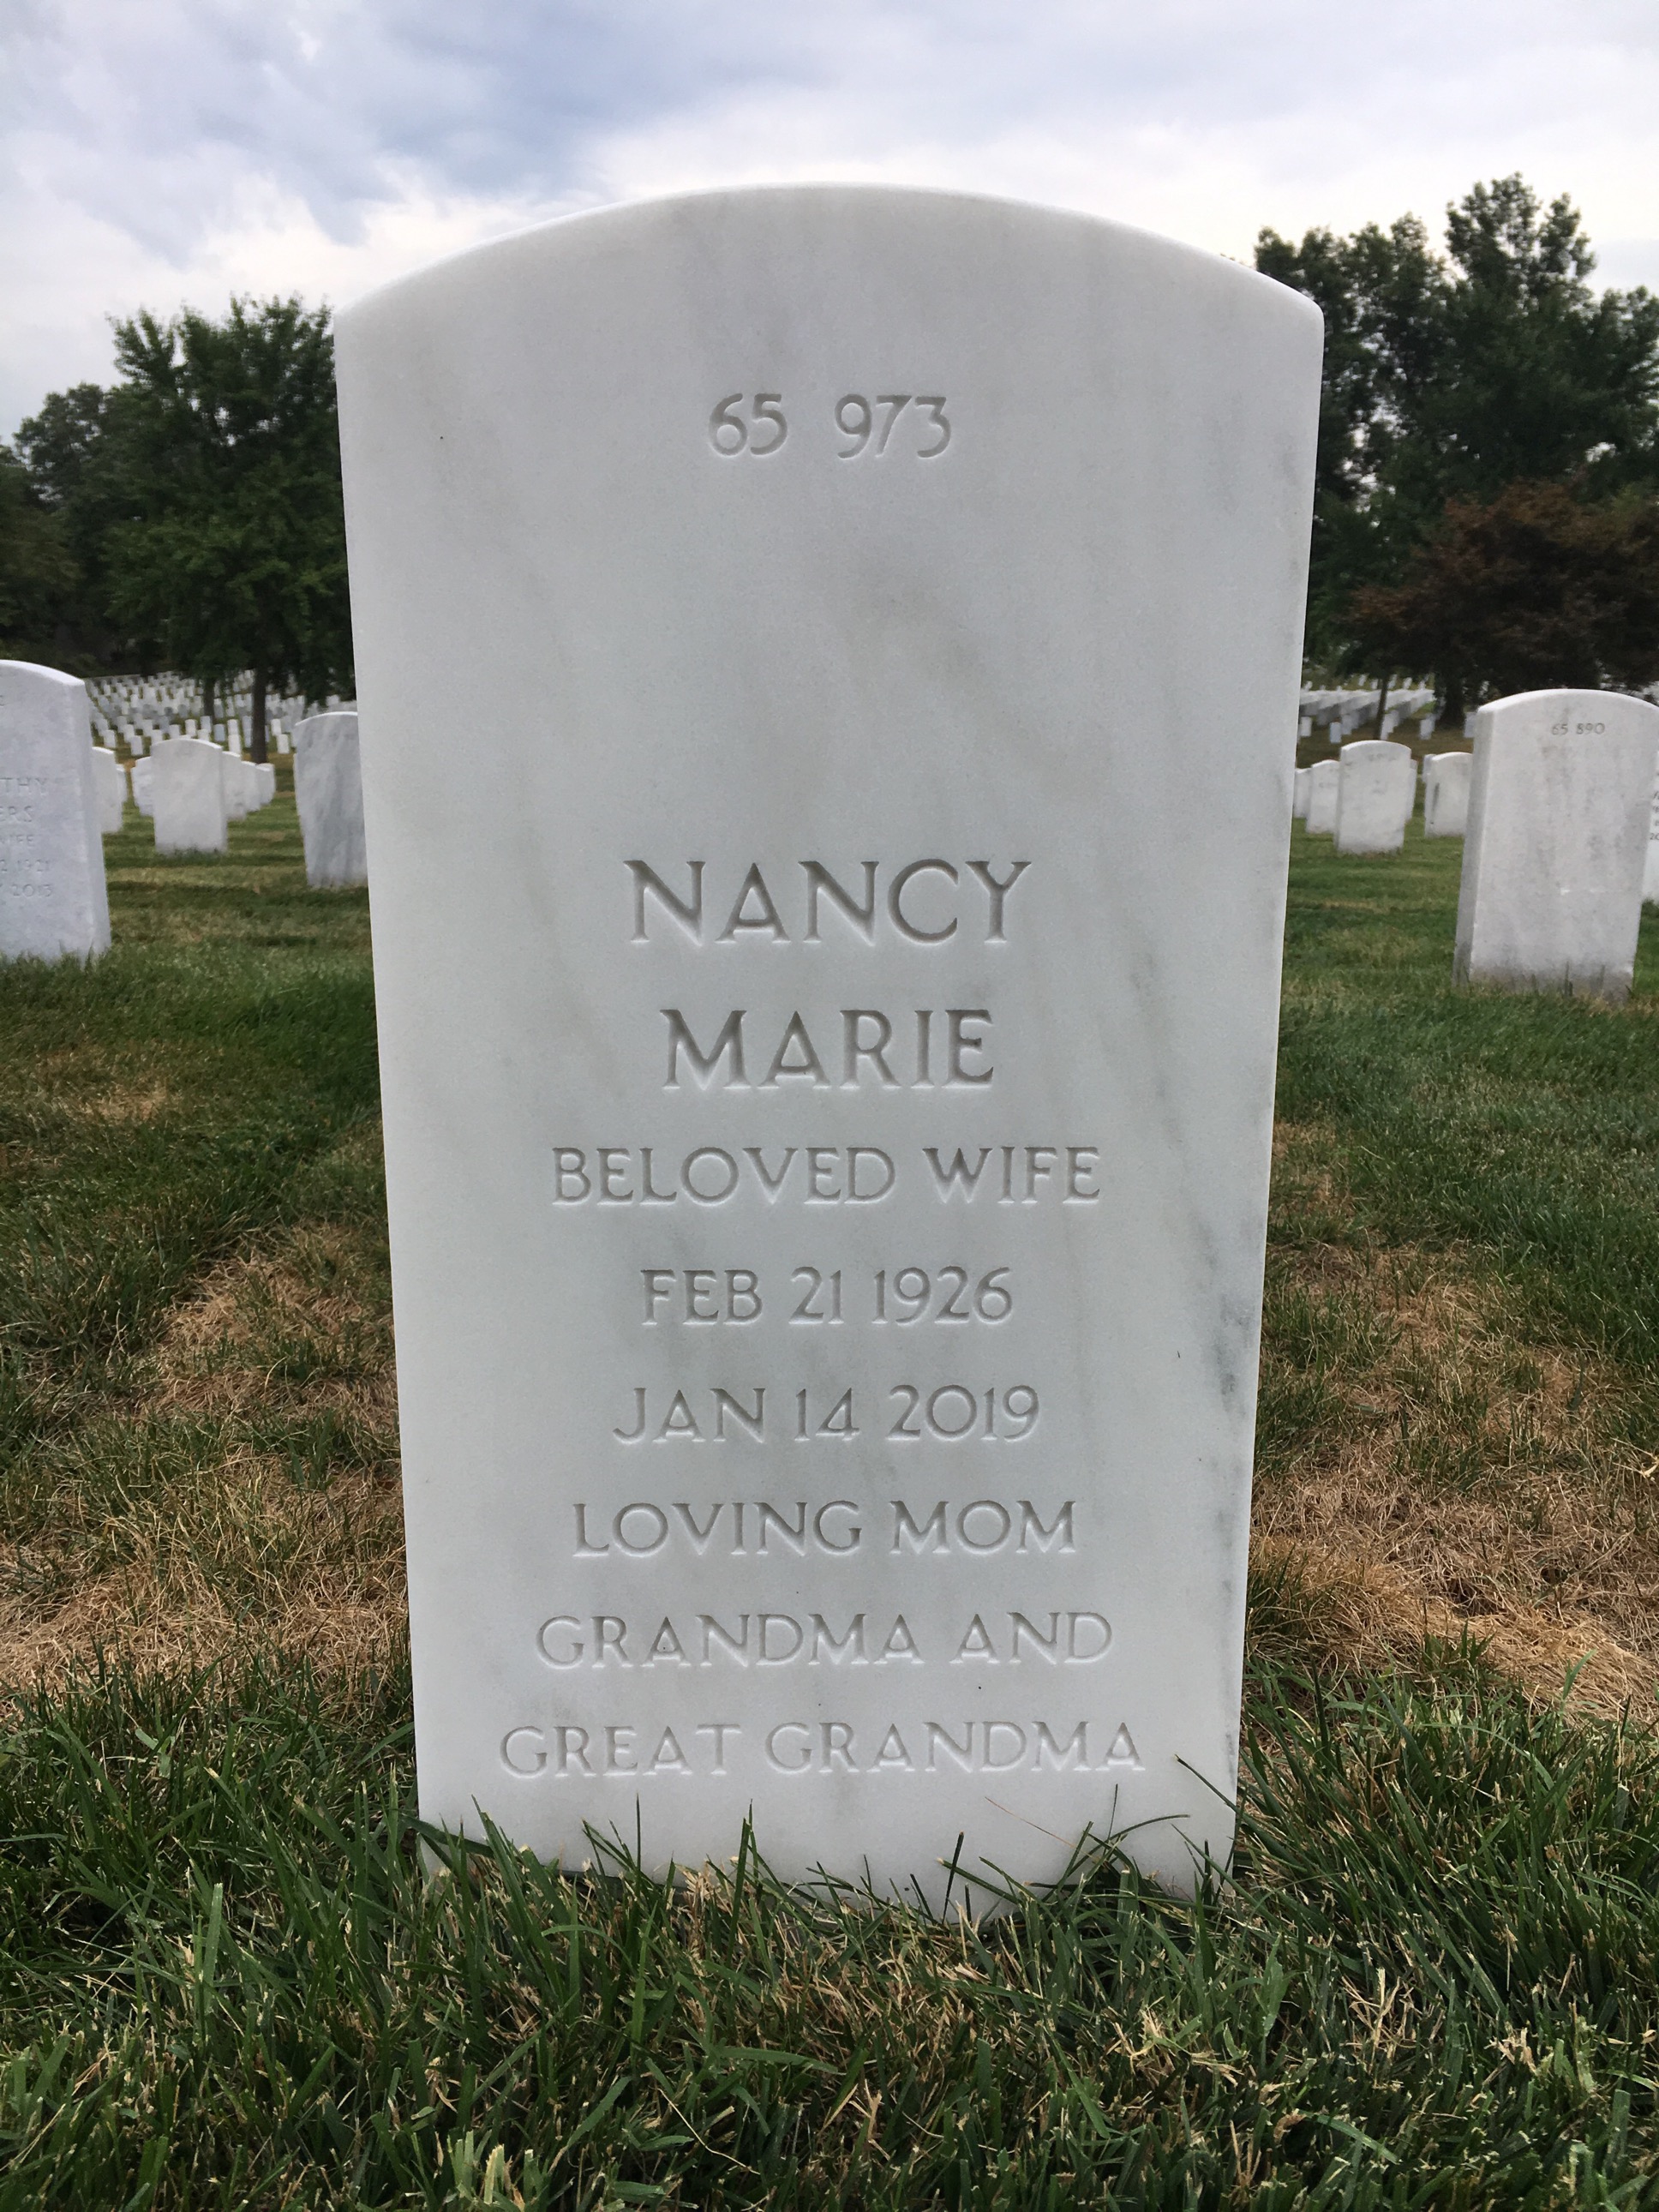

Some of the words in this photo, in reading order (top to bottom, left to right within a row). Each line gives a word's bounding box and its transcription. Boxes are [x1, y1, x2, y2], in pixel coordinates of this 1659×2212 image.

[710, 392, 788, 457] 65
[834, 393, 951, 459] 973
[1551, 723, 1568, 735] 65
[1576, 722, 1605, 734] 890
[623, 858, 1032, 945] NANCY
[659, 1008, 995, 1090] MARIE
[552, 1146, 896, 1205] BELOVED
[922, 1146, 1101, 1205] WIFE
[639, 1268, 764, 1327] FEB
[789, 1266, 844, 1327] 21
[871, 1266, 1013, 1326] 1926
[612, 1387, 768, 1445] JAN
[793, 1387, 859, 1442] 14
[885, 1384, 1040, 1443] 2019
[572, 1500, 862, 1558] LOVING
[889, 1498, 1077, 1556] MOM
[536, 1613, 925, 1669] GRANDMA
[949, 1611, 1114, 1666] AND
[499, 1722, 742, 1779] GREAT
[764, 1720, 1147, 1776] GRANDMA
